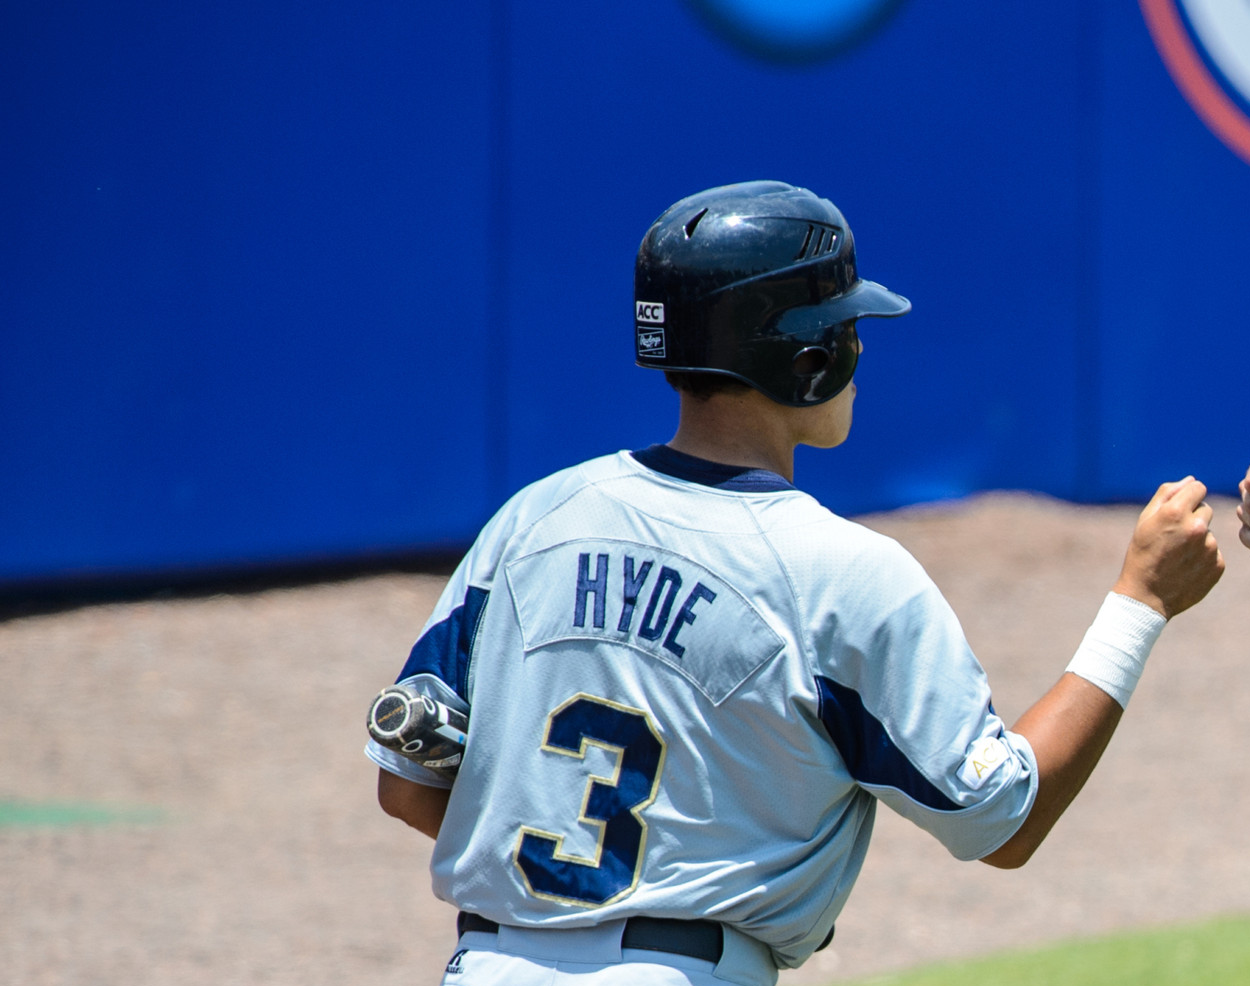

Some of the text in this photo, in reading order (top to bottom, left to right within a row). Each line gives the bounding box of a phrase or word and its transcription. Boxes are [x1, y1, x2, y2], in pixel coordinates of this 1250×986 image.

[637, 303, 660, 320] ACC
[573, 553, 718, 659] HYDE
[973, 742, 999, 780] AC
[512, 692, 668, 909] 3
